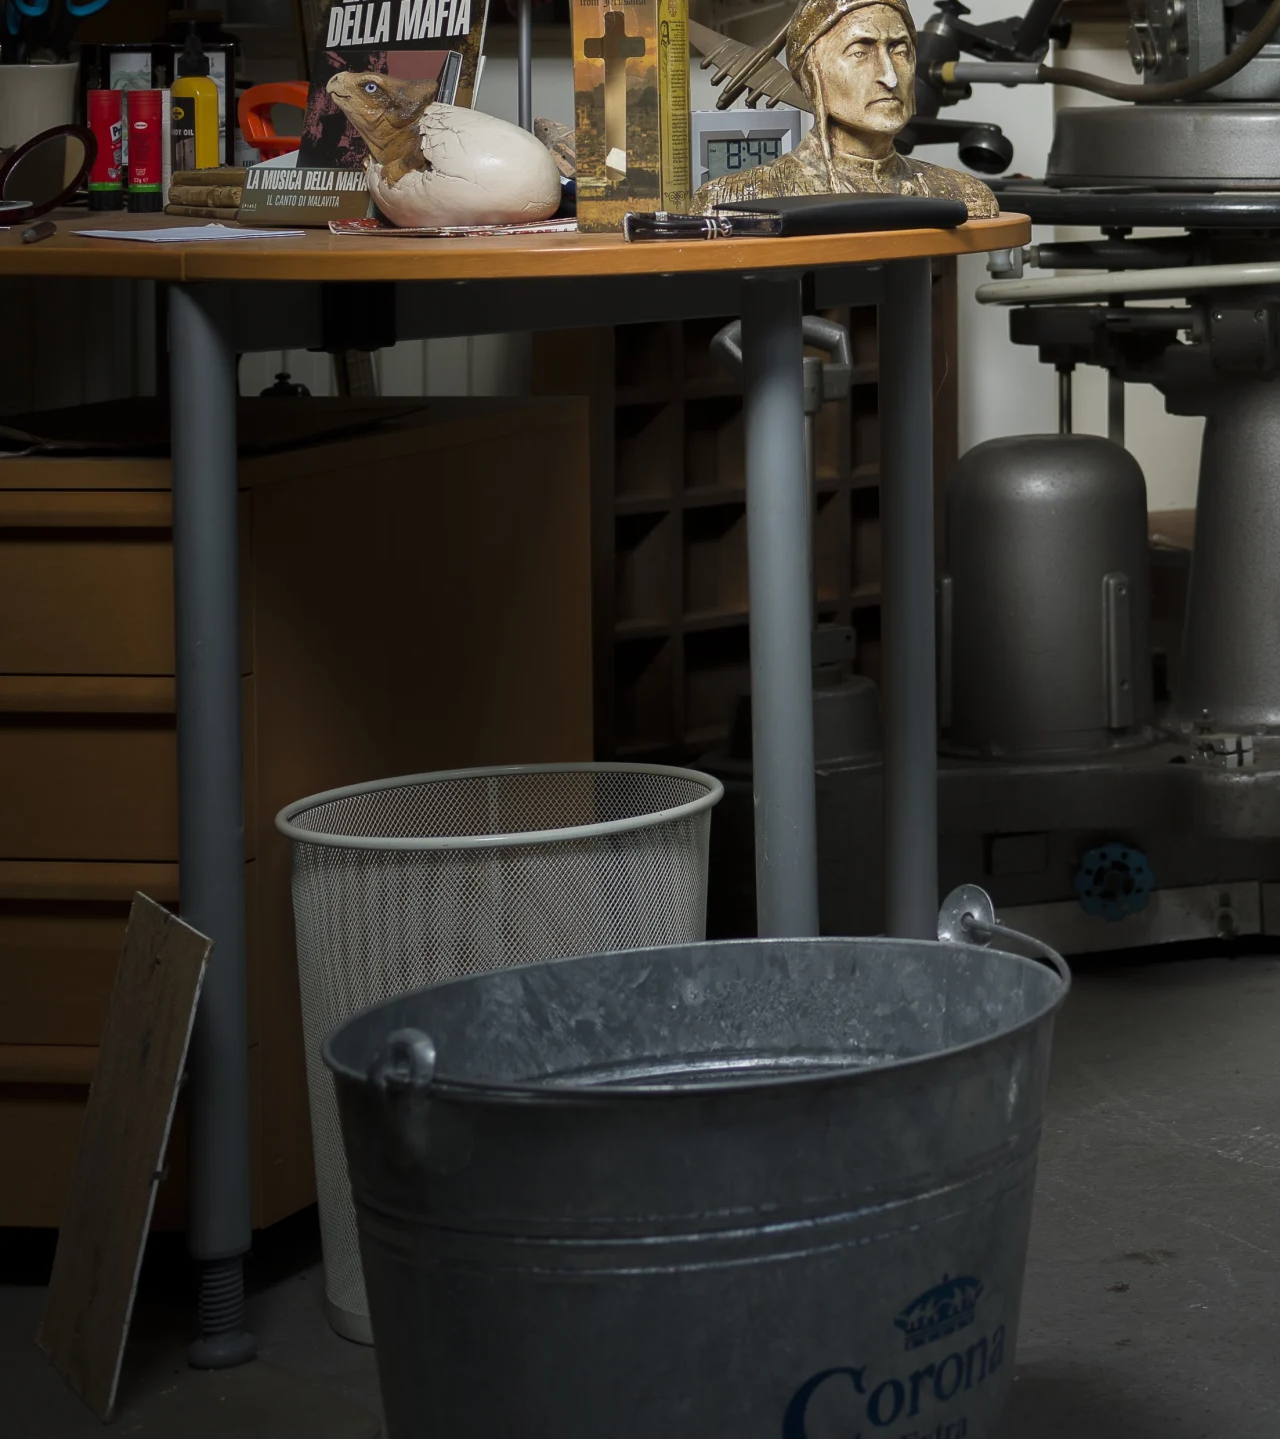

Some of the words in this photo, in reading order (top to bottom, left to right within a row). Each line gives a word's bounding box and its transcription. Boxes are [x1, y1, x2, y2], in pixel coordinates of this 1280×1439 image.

[326, 1, 391, 48] DELLA
[727, 140, 778, 169] 8:44
[246, 170, 260, 190] LA
[261, 169, 301, 191] MUSICA
[303, 170, 335, 191] DELLA
[336, 171, 368, 192] MAFIA
[266, 194, 273, 206] IL
[274, 194, 297, 207] CANTO
[298, 195, 305, 207] DI
[307, 195, 340, 208] MALAVITA
[782, 1324, 1006, 1439] Corona
